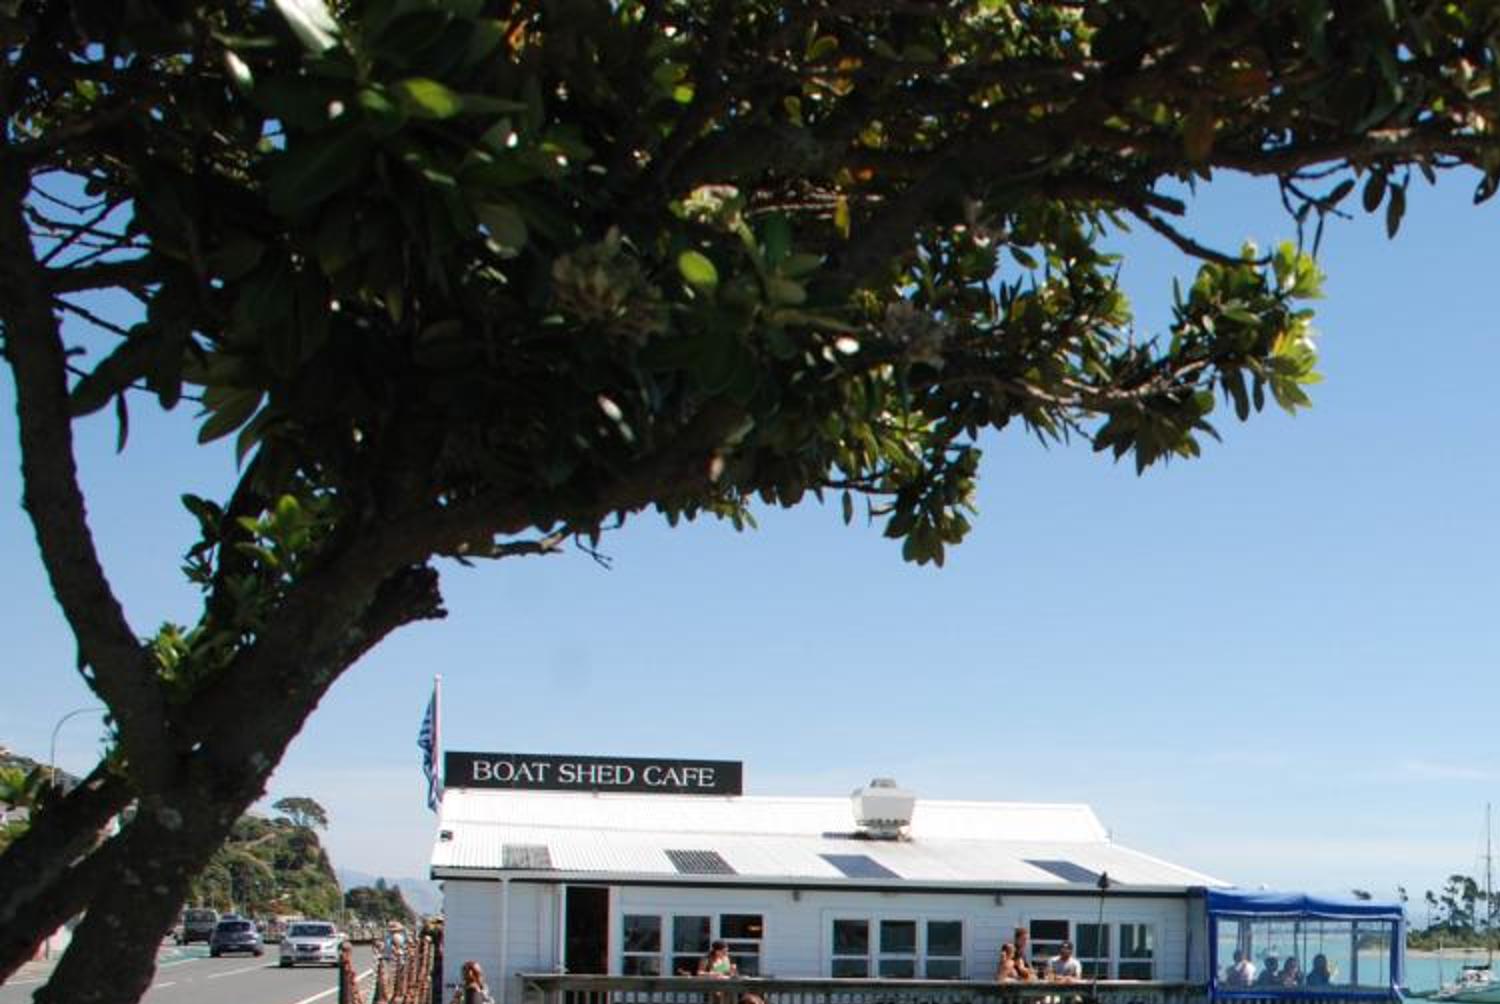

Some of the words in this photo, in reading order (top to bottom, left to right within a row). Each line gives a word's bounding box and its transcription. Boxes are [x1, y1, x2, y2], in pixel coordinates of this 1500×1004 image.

[472, 760, 551, 783] BOAT
[557, 763, 635, 785] SHED
[642, 765, 716, 787] CAFE
